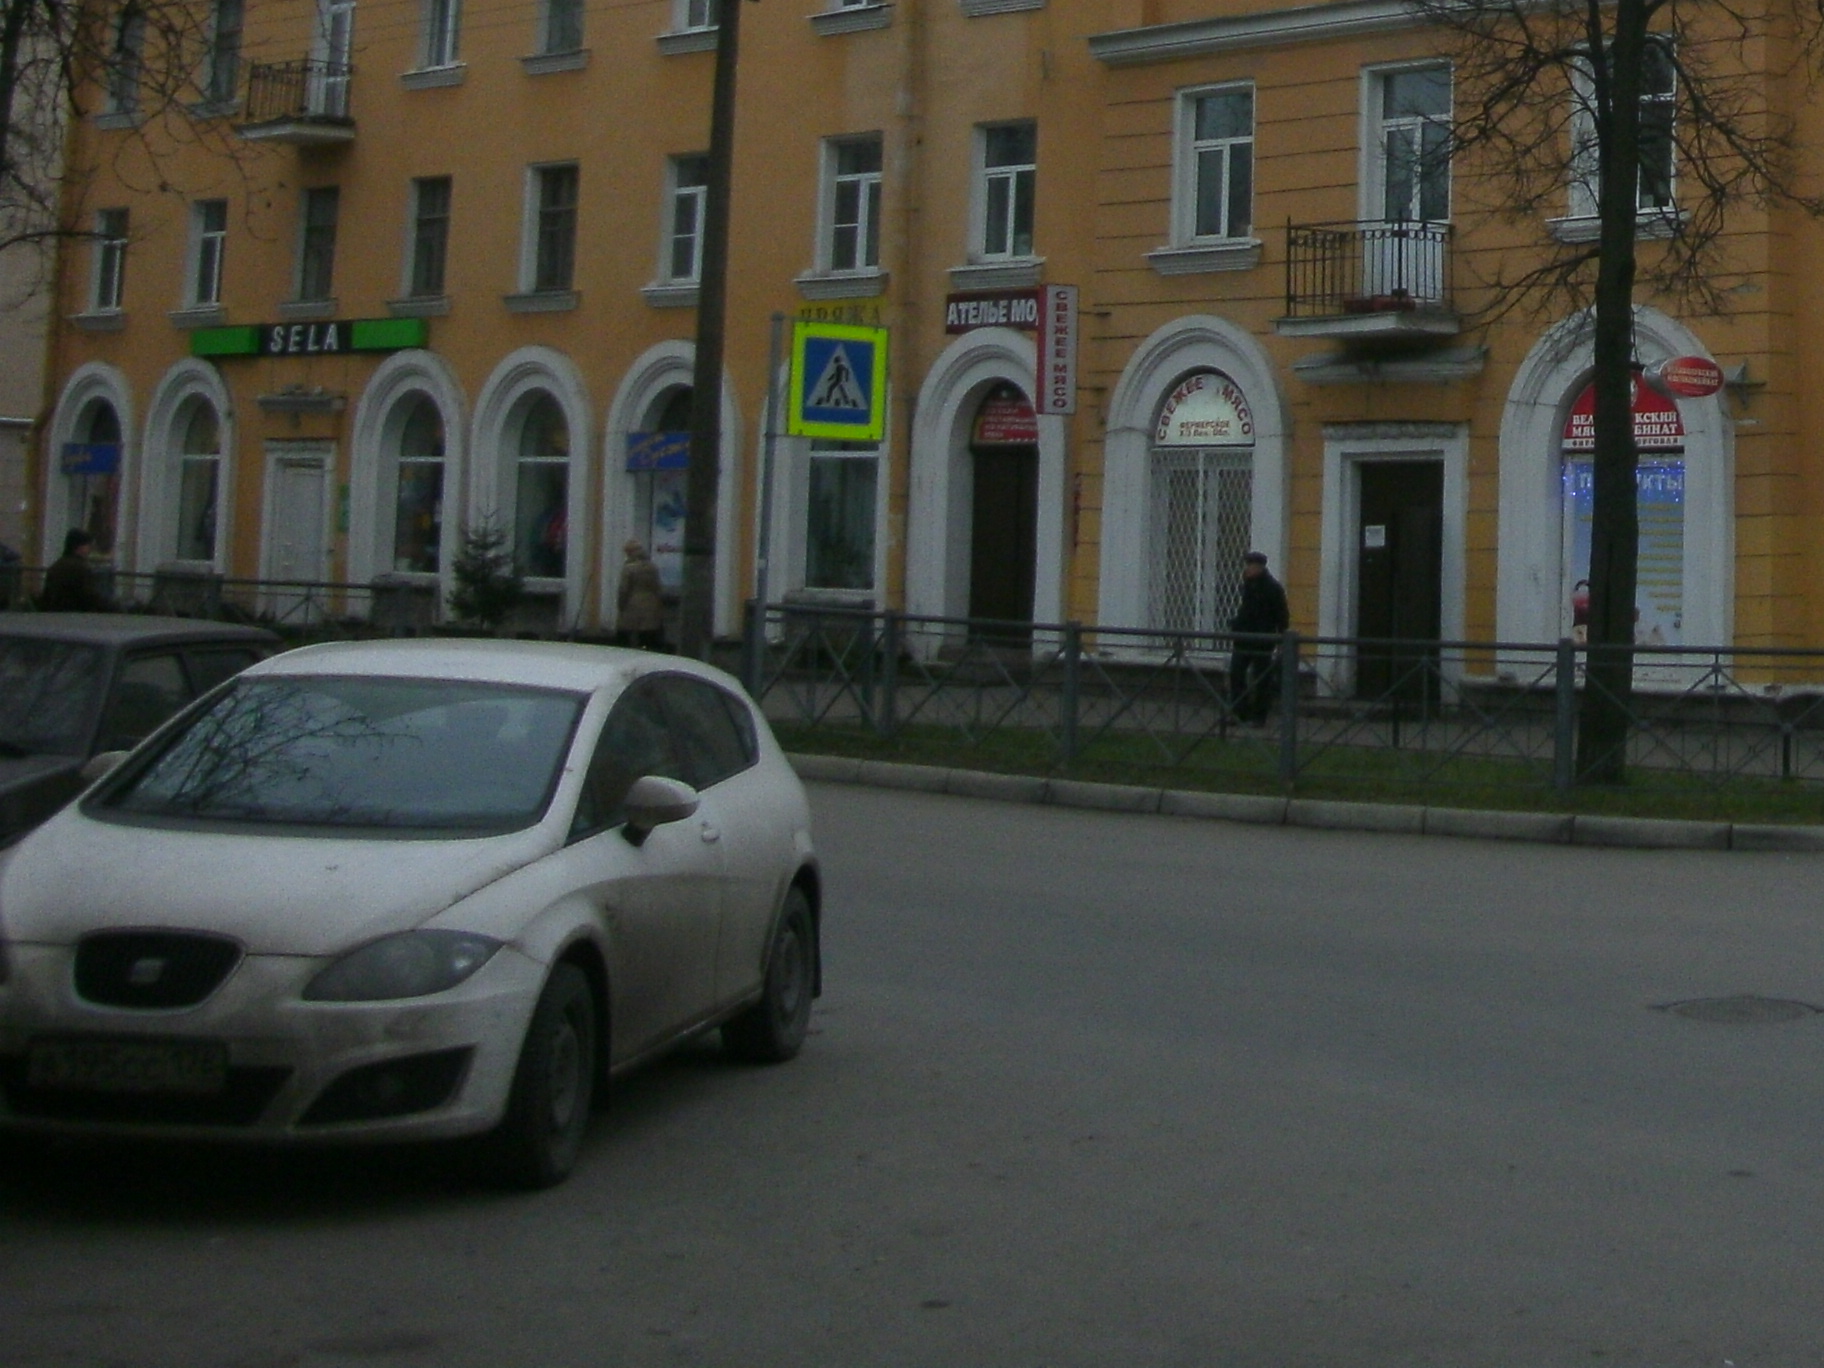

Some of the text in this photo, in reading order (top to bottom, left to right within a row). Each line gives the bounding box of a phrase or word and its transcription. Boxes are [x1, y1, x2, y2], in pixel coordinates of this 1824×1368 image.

[947, 298, 1038, 325] АТЕЛЬЕ МО
[270, 323, 339, 353] SELA
[1053, 291, 1069, 408] СВЕЖЕЕ МЯСО
[1158, 377, 1251, 440] СВЕЖЕЕ МЯСО
